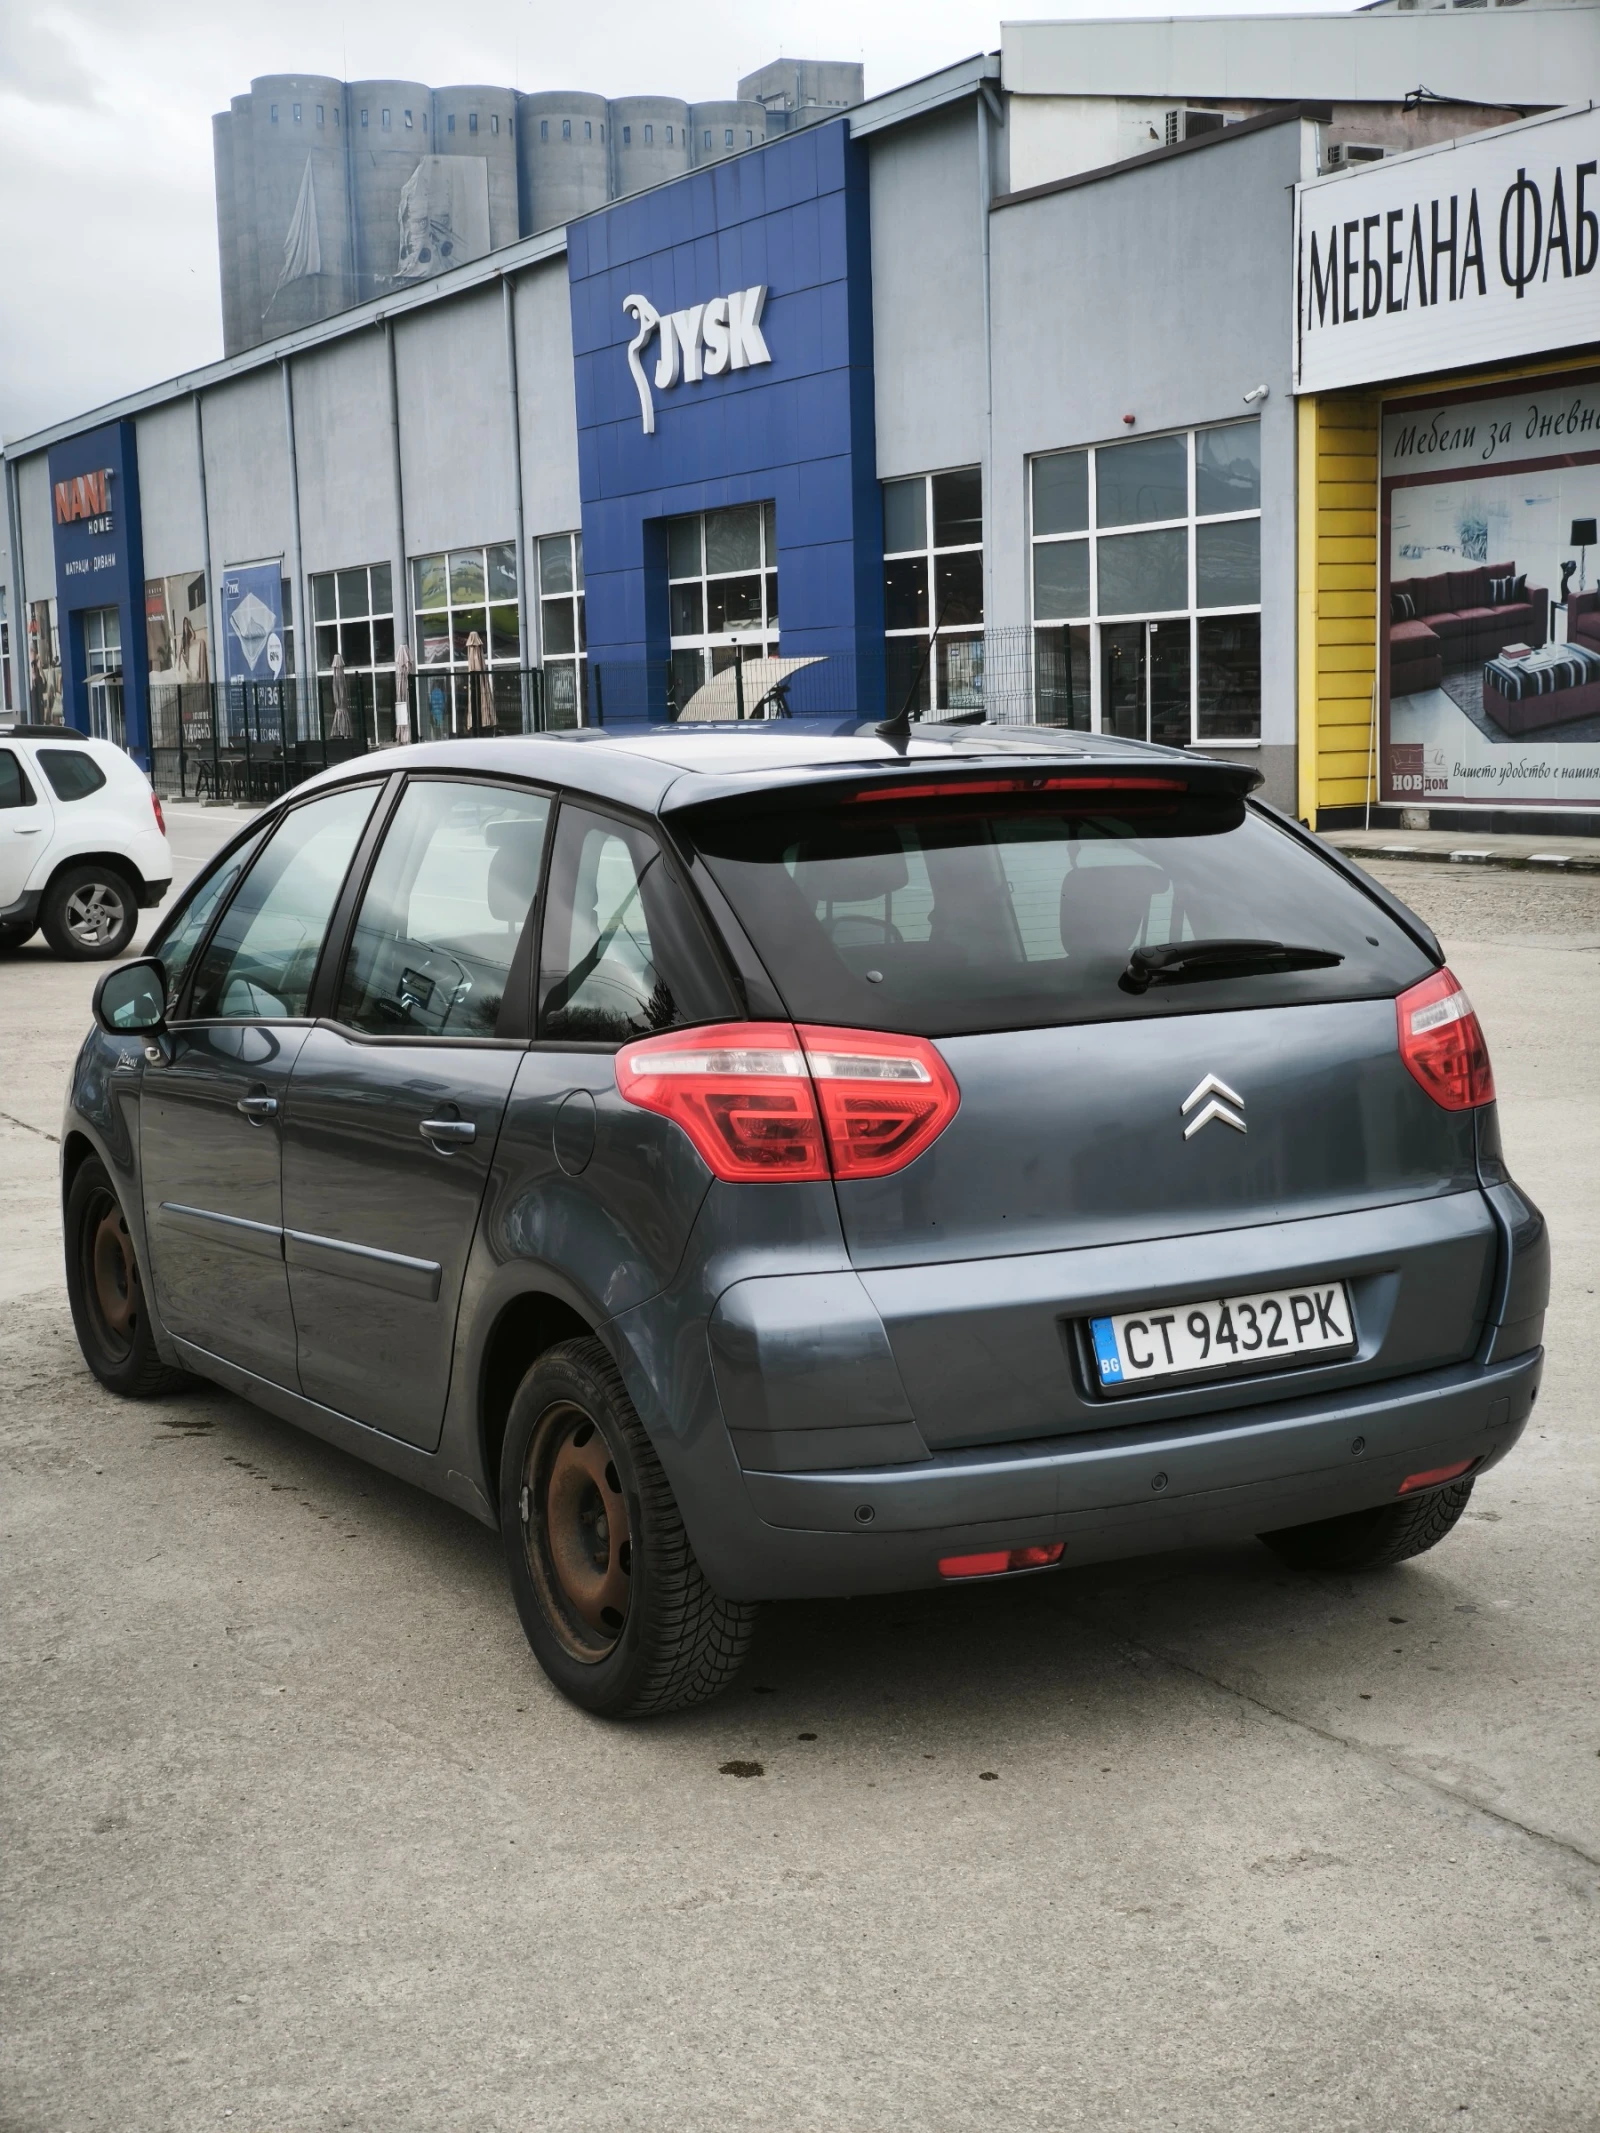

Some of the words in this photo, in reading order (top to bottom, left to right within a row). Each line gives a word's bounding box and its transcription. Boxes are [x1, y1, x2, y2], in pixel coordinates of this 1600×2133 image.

[1307, 187, 1487, 331] МЕБЕЛНА
[654, 284, 772, 389] JYSK
[1393, 411, 1476, 458] Мебели
[1482, 421, 1512, 460] за
[55, 468, 112, 525] NANI
[88, 517, 113, 535] HOME
[65, 558, 90, 576] МАТРАЦИ
[93, 552, 116, 572] ДИВАНИ
[1392, 775, 1423, 791] НОВ
[1453, 762, 1497, 779] Вашето
[1497, 758, 1551, 786] удобство
[1561, 767, 1600, 779] нашия
[1123, 1315, 1176, 1370] CT
[1186, 1299, 1290, 1360] 9432
[1288, 1290, 1345, 1344] PK
[1100, 1357, 1120, 1375] BG
